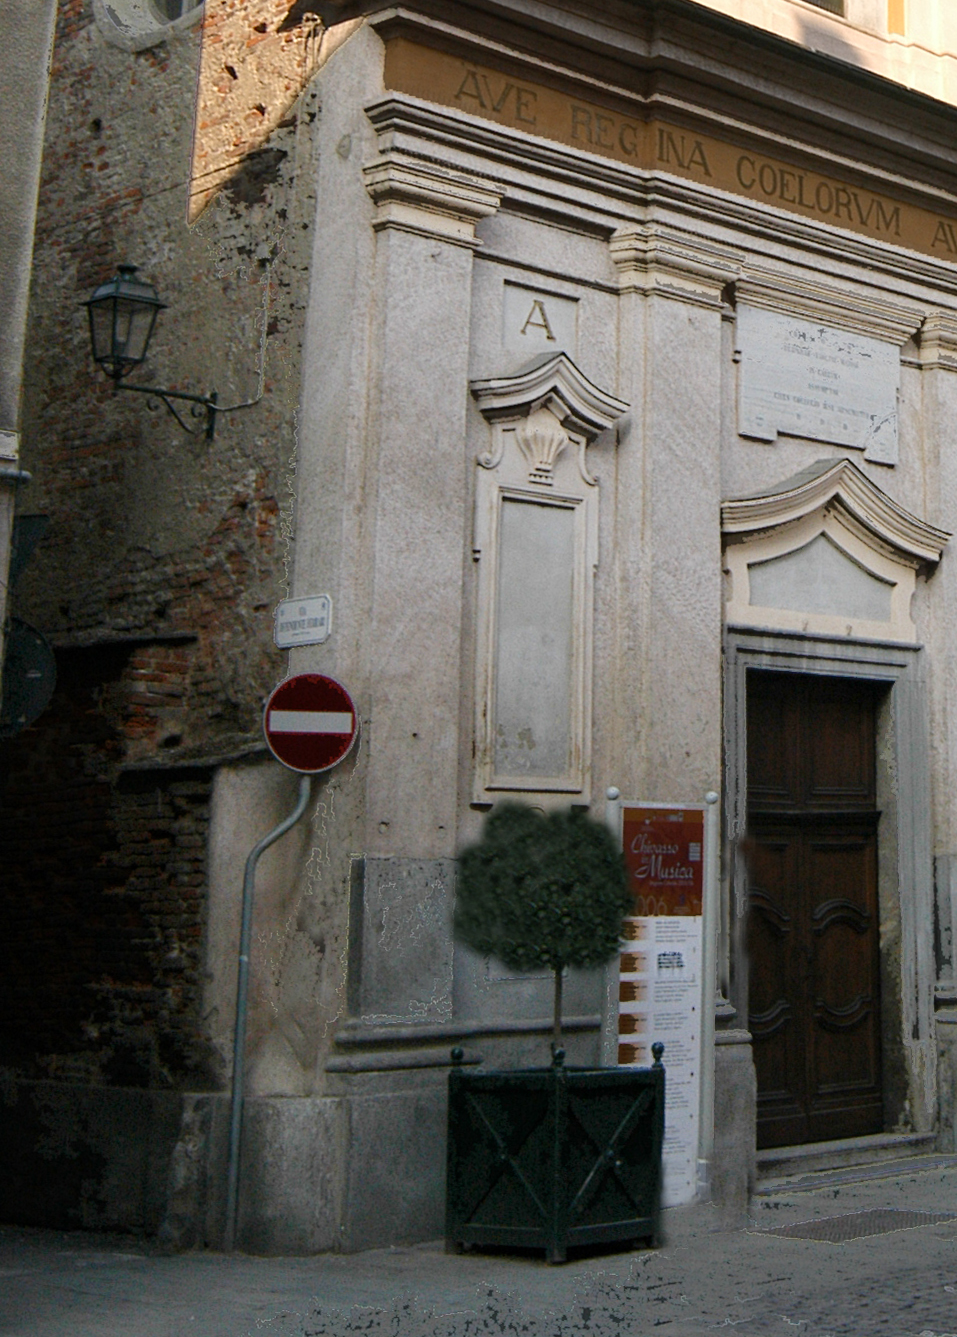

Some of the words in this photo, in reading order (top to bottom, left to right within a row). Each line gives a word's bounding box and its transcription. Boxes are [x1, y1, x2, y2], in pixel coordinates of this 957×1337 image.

[454, 67, 539, 126] AVE
[735, 155, 902, 237] COELORVM
[520, 299, 556, 342] A
[631, 832, 680, 855] Chivasso
[634, 854, 694, 881] Musica
